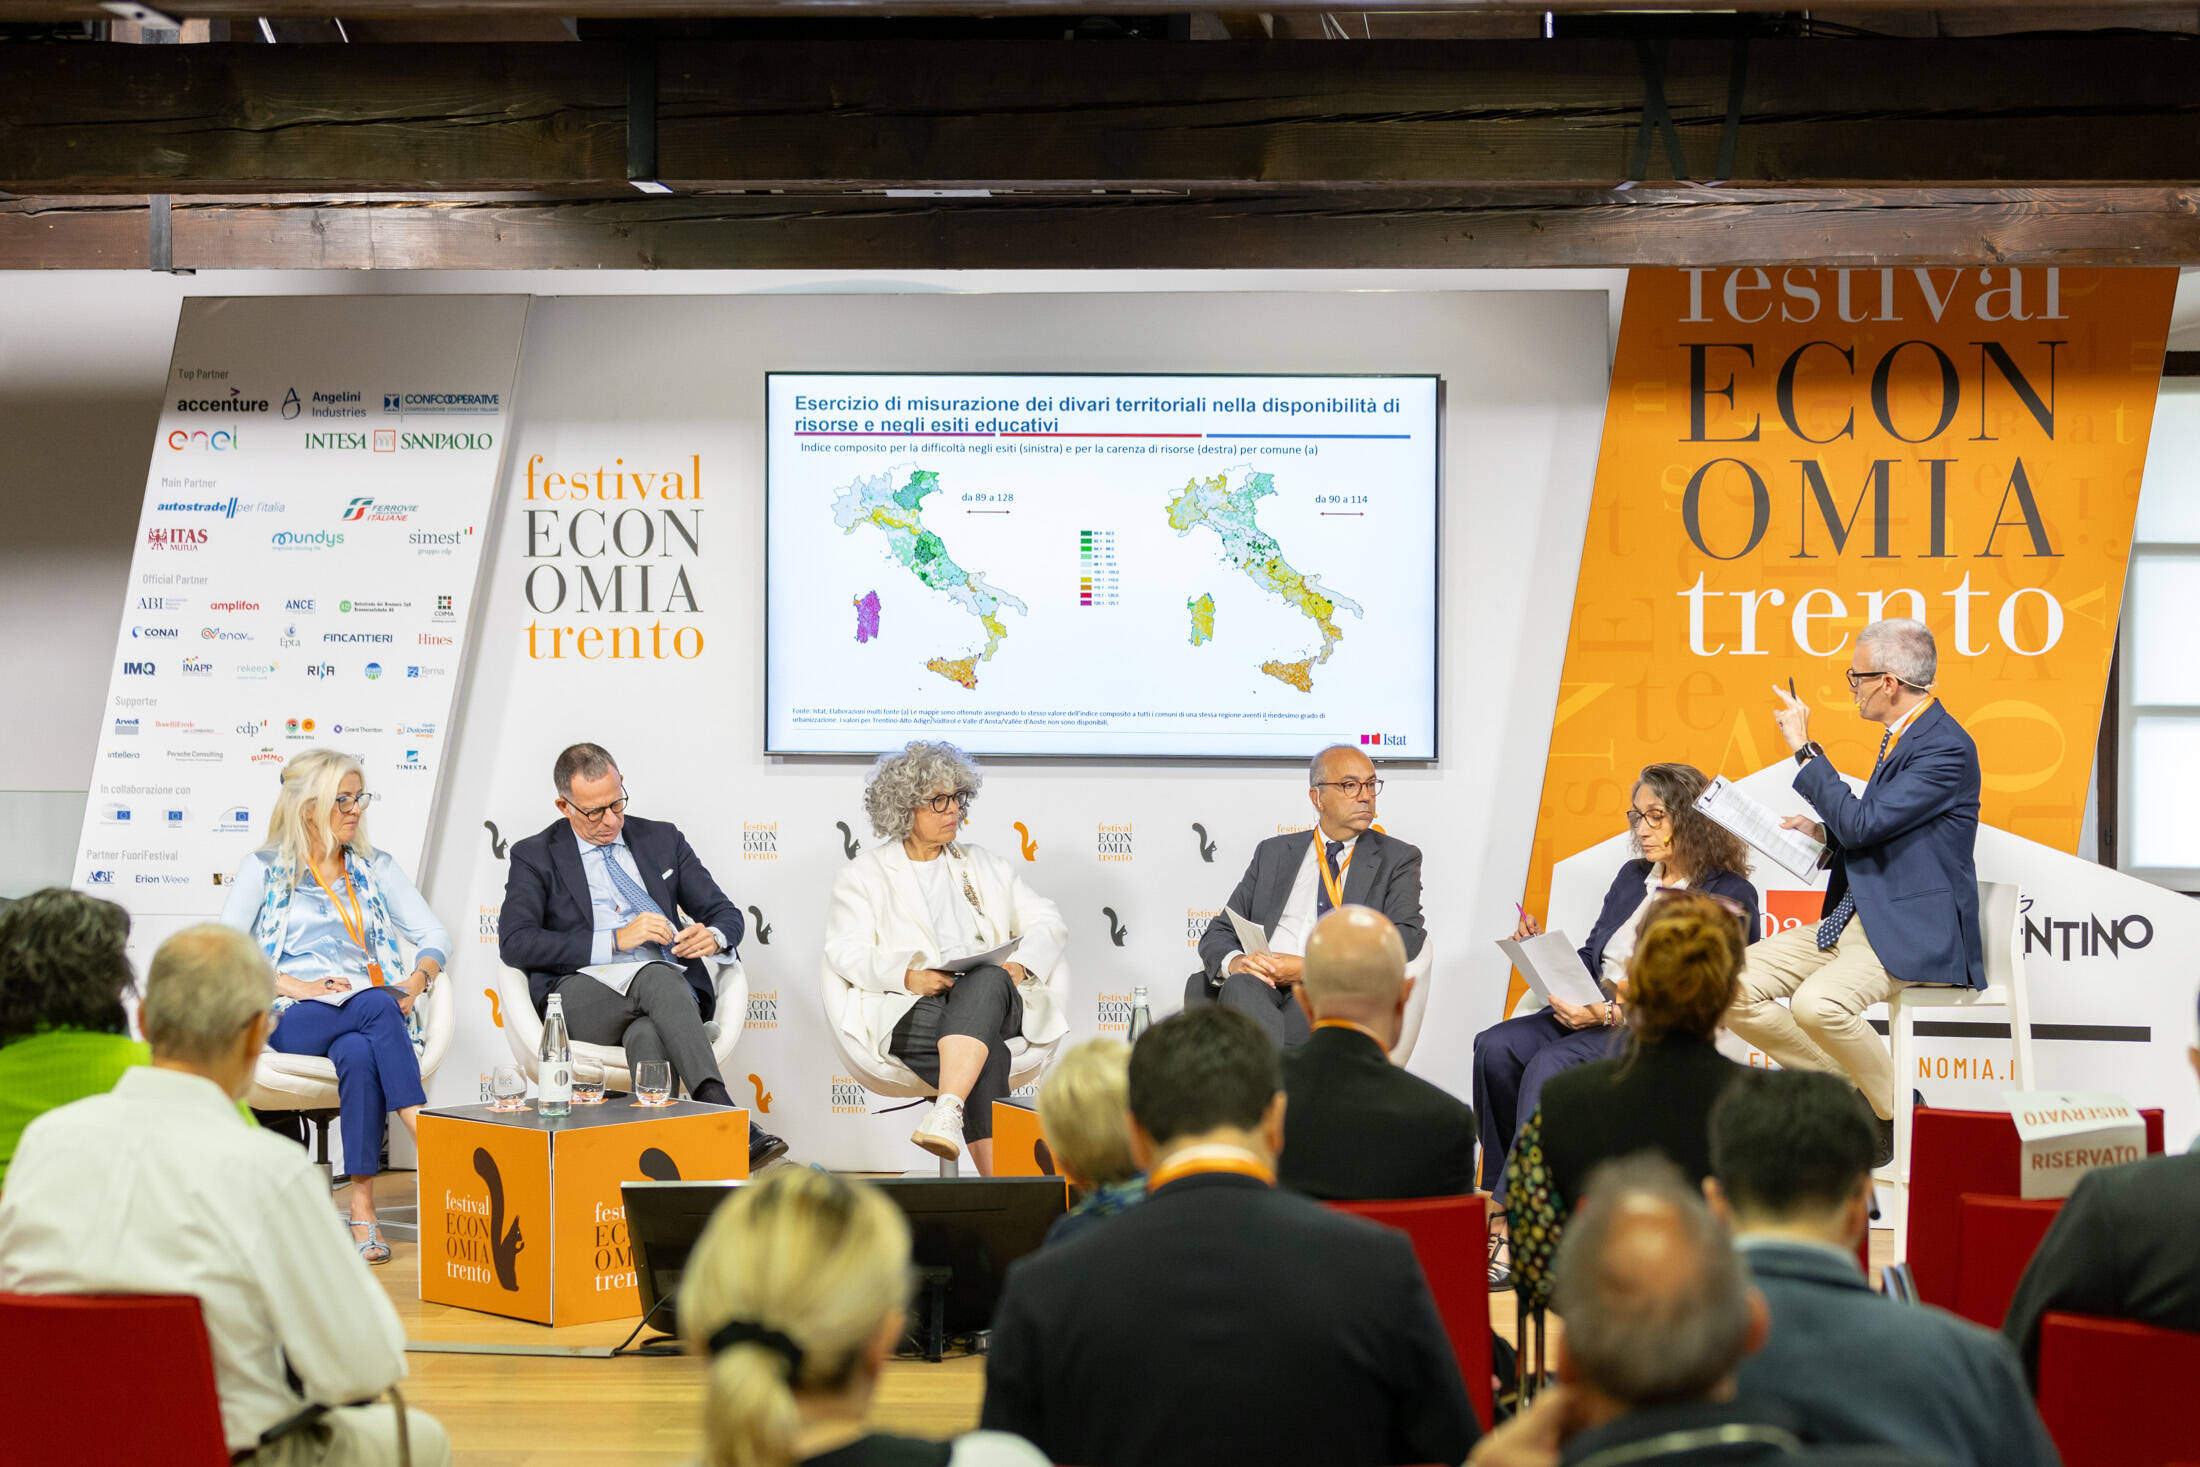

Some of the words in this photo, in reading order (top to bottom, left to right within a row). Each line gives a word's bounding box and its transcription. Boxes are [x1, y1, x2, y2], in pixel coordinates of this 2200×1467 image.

[1678, 268, 2069, 324] festival
[179, 368, 194, 381] Top
[197, 368, 229, 380] Partner
[312, 391, 361, 405] Angelini
[1678, 340, 2067, 444] ECON
[177, 397, 269, 412] accenture
[796, 395, 879, 411] Esercizio
[885, 395, 901, 411] di
[908, 396, 1019, 412] misurazione
[1026, 396, 1052, 411] dei
[1059, 396, 1109, 412] divari
[1116, 396, 1206, 412] territoriali
[1213, 397, 1256, 413] nella
[1263, 397, 1376, 417] disponibilità
[1384, 398, 1400, 413] di
[312, 407, 366, 417] Industries
[795, 416, 858, 431] risorse
[864, 419, 874, 431] e
[881, 417, 924, 433] negli
[931, 417, 968, 432] esiti
[975, 418, 1059, 432] educativi
[168, 424, 238, 450] enel
[305, 432, 367, 449] INTESA
[400, 432, 493, 450] SANPAOLO
[801, 442, 831, 453] Indice
[834, 443, 887, 455] composito
[890, 445, 907, 455] per
[910, 443, 919, 453] la
[921, 443, 965, 453] difficoltà
[969, 443, 993, 456] negli
[996, 443, 1016, 453] esiti
[1019, 443, 1063, 456] (sinistra)
[1075, 446, 1092, 456] per
[1095, 444, 1104, 454] la
[1107, 446, 1145, 454] carenza
[1148, 444, 1158, 454] di
[1161, 444, 1195, 455] risorse
[1198, 444, 1237, 457] (destra)
[1239, 447, 1257, 457] per
[1260, 447, 1302, 456] comune
[1304, 445, 1319, 457] (a)
[161, 478, 181, 488] Main
[184, 478, 216, 489] Partner
[522, 454, 704, 501] festival
[961, 493, 973, 502] da
[975, 493, 987, 502] 89
[997, 493, 1014, 502] 128
[1315, 494, 1326, 503] da
[1328, 495, 1341, 504] 90
[1351, 495, 1368, 504] 114
[157, 501, 227, 512] autostrade
[236, 503, 254, 516] per
[371, 504, 418, 512] FERROVIE
[1682, 457, 2065, 561] OMIA
[367, 514, 409, 522] ITALIANE
[170, 528, 208, 544] ITAS
[271, 529, 344, 548] mundys
[409, 529, 461, 545] simest
[523, 508, 704, 558] ECON
[142, 574, 174, 585] Official
[175, 575, 208, 585] Partner
[524, 563, 704, 614] OMIA
[137, 597, 164, 610] ABI
[210, 600, 260, 613] amplifon
[285, 600, 314, 610] ANCE
[144, 628, 178, 638] CONAI
[219, 631, 248, 641] enav
[323, 633, 393, 643] FINCANTIERI
[418, 633, 453, 645] Hines
[523, 618, 704, 660] trento
[280, 637, 301, 648] Epta
[124, 662, 156, 676] IMQ
[182, 663, 213, 673] INAPP
[237, 663, 268, 674] rekeep
[115, 696, 157, 707] Supporter
[236, 722, 259, 737] cdp
[1383, 733, 1407, 746] Istat
[251, 754, 284, 763] RUMMO
[100, 784, 109, 794] In
[111, 785, 173, 795] collaborazione
[175, 786, 191, 795] con
[744, 831, 777, 841] ECON
[1098, 832, 1132, 842] ECON
[744, 841, 777, 852] OMIA
[1098, 843, 1132, 853] OMIA
[86, 850, 119, 860] Partner
[121, 850, 178, 861] FuoriFestival
[135, 874, 160, 884] Erion
[161, 874, 190, 884] Weee
[2022, 912, 2153, 961] NTINO
[832, 1095, 865, 1105] OMIA
[2024, 1106, 2129, 1126] RISERVATO
[2031, 1145, 2138, 1171] RISERVATO
[446, 1189, 489, 1216] festival
[595, 1202, 626, 1223] fest
[446, 1212, 489, 1240] ECON
[596, 1222, 627, 1248] EC
[446, 1236, 490, 1264] OMIA
[595, 1246, 632, 1272] OM
[447, 1260, 491, 1285] trento
[595, 1271, 638, 1292] tren
